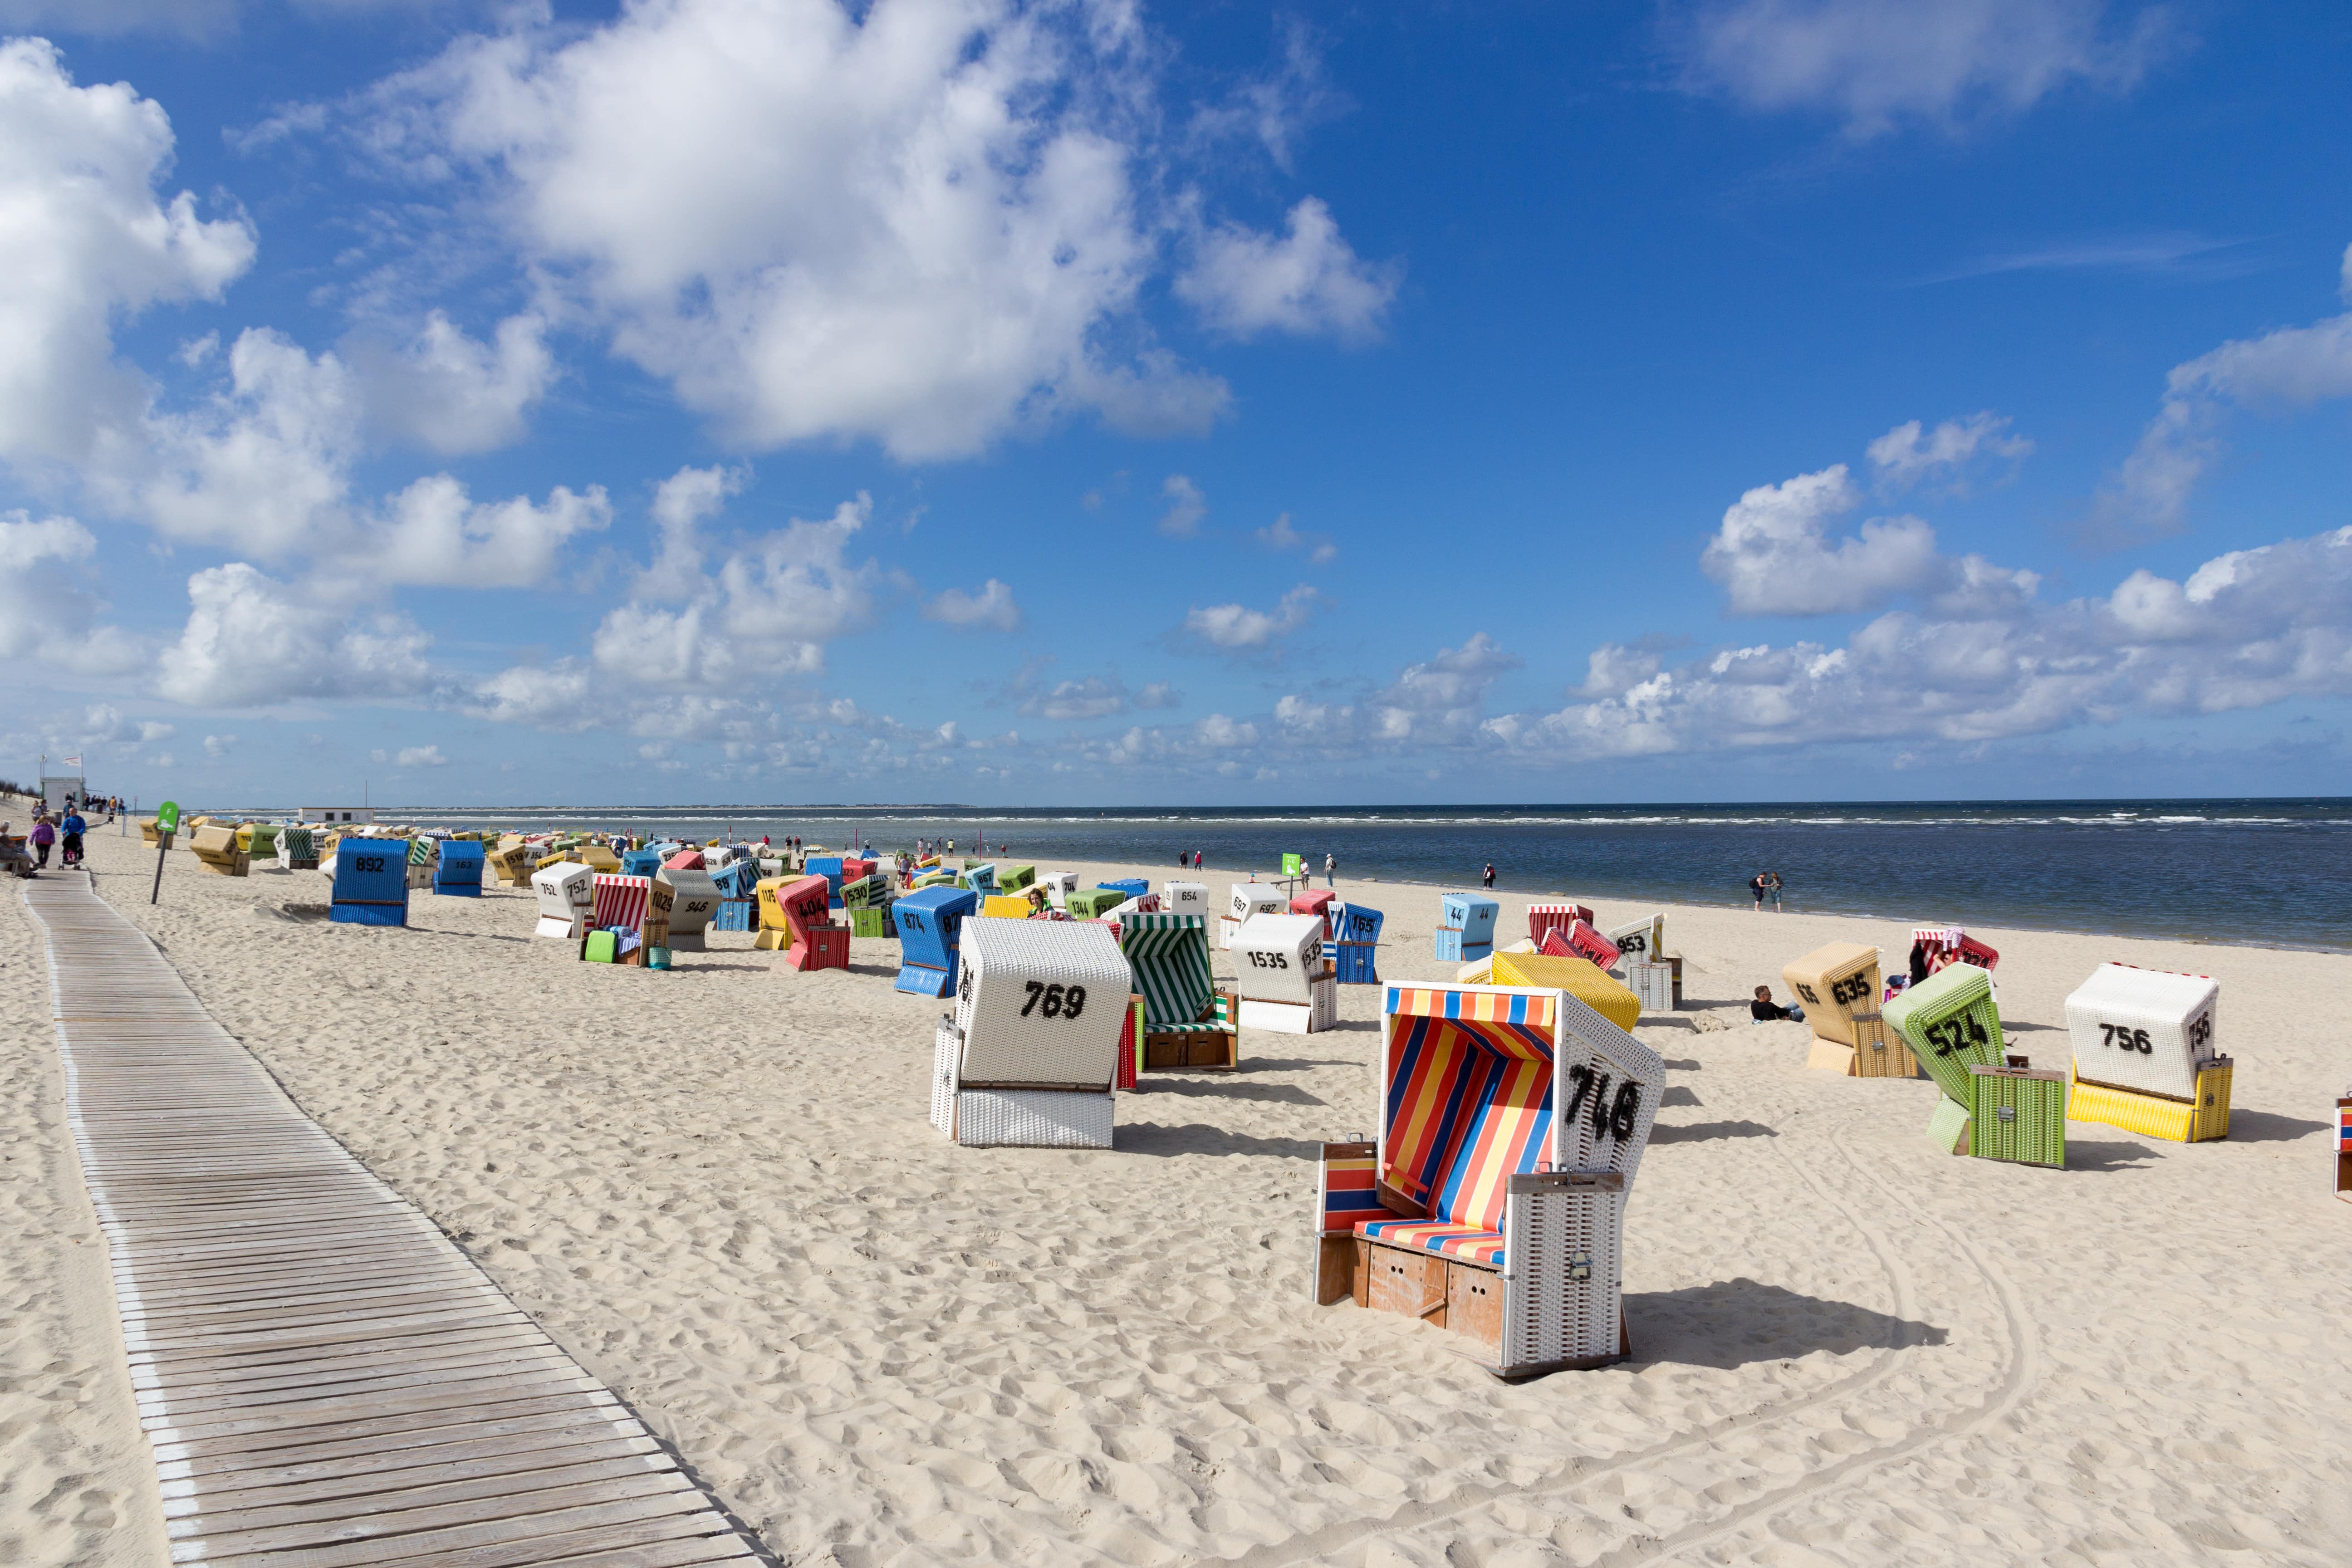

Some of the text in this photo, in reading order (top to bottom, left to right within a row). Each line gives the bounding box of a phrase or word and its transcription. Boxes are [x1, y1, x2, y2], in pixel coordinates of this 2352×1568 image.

[356, 857, 384, 872] 892
[506, 852, 524, 865] 1519
[715, 877, 730, 891] 88
[978, 872, 991, 884] 867
[1002, 880, 1014, 888] 500
[1019, 875, 1031, 884] 500
[541, 883, 557, 896] 752
[567, 879, 587, 897] 752
[848, 885, 867, 902] 530
[1064, 881, 1075, 892] 704
[652, 891, 674, 912] 1029
[762, 889, 776, 903] 1175
[1182, 891, 1197, 901] 654
[685, 901, 709, 913] 946
[799, 897, 826, 917] 404
[1072, 901, 1089, 917] 1344
[1234, 897, 1246, 912] 697
[1259, 904, 1277, 914] 697
[1451, 907, 1461, 921] 44
[1480, 908, 1489, 920] 44
[903, 912, 925, 934] 874
[1353, 915, 1374, 933] 165
[1617, 936, 1646, 955] 953
[1248, 951, 1288, 969] 1535
[1302, 937, 1321, 970] 1535
[1833, 972, 1871, 1005] 635
[1020, 980, 1087, 1019] 769
[1924, 1013, 1989, 1057] 524
[2098, 1023, 2152, 1054] 756
[2189, 1011, 2210, 1053] 756
